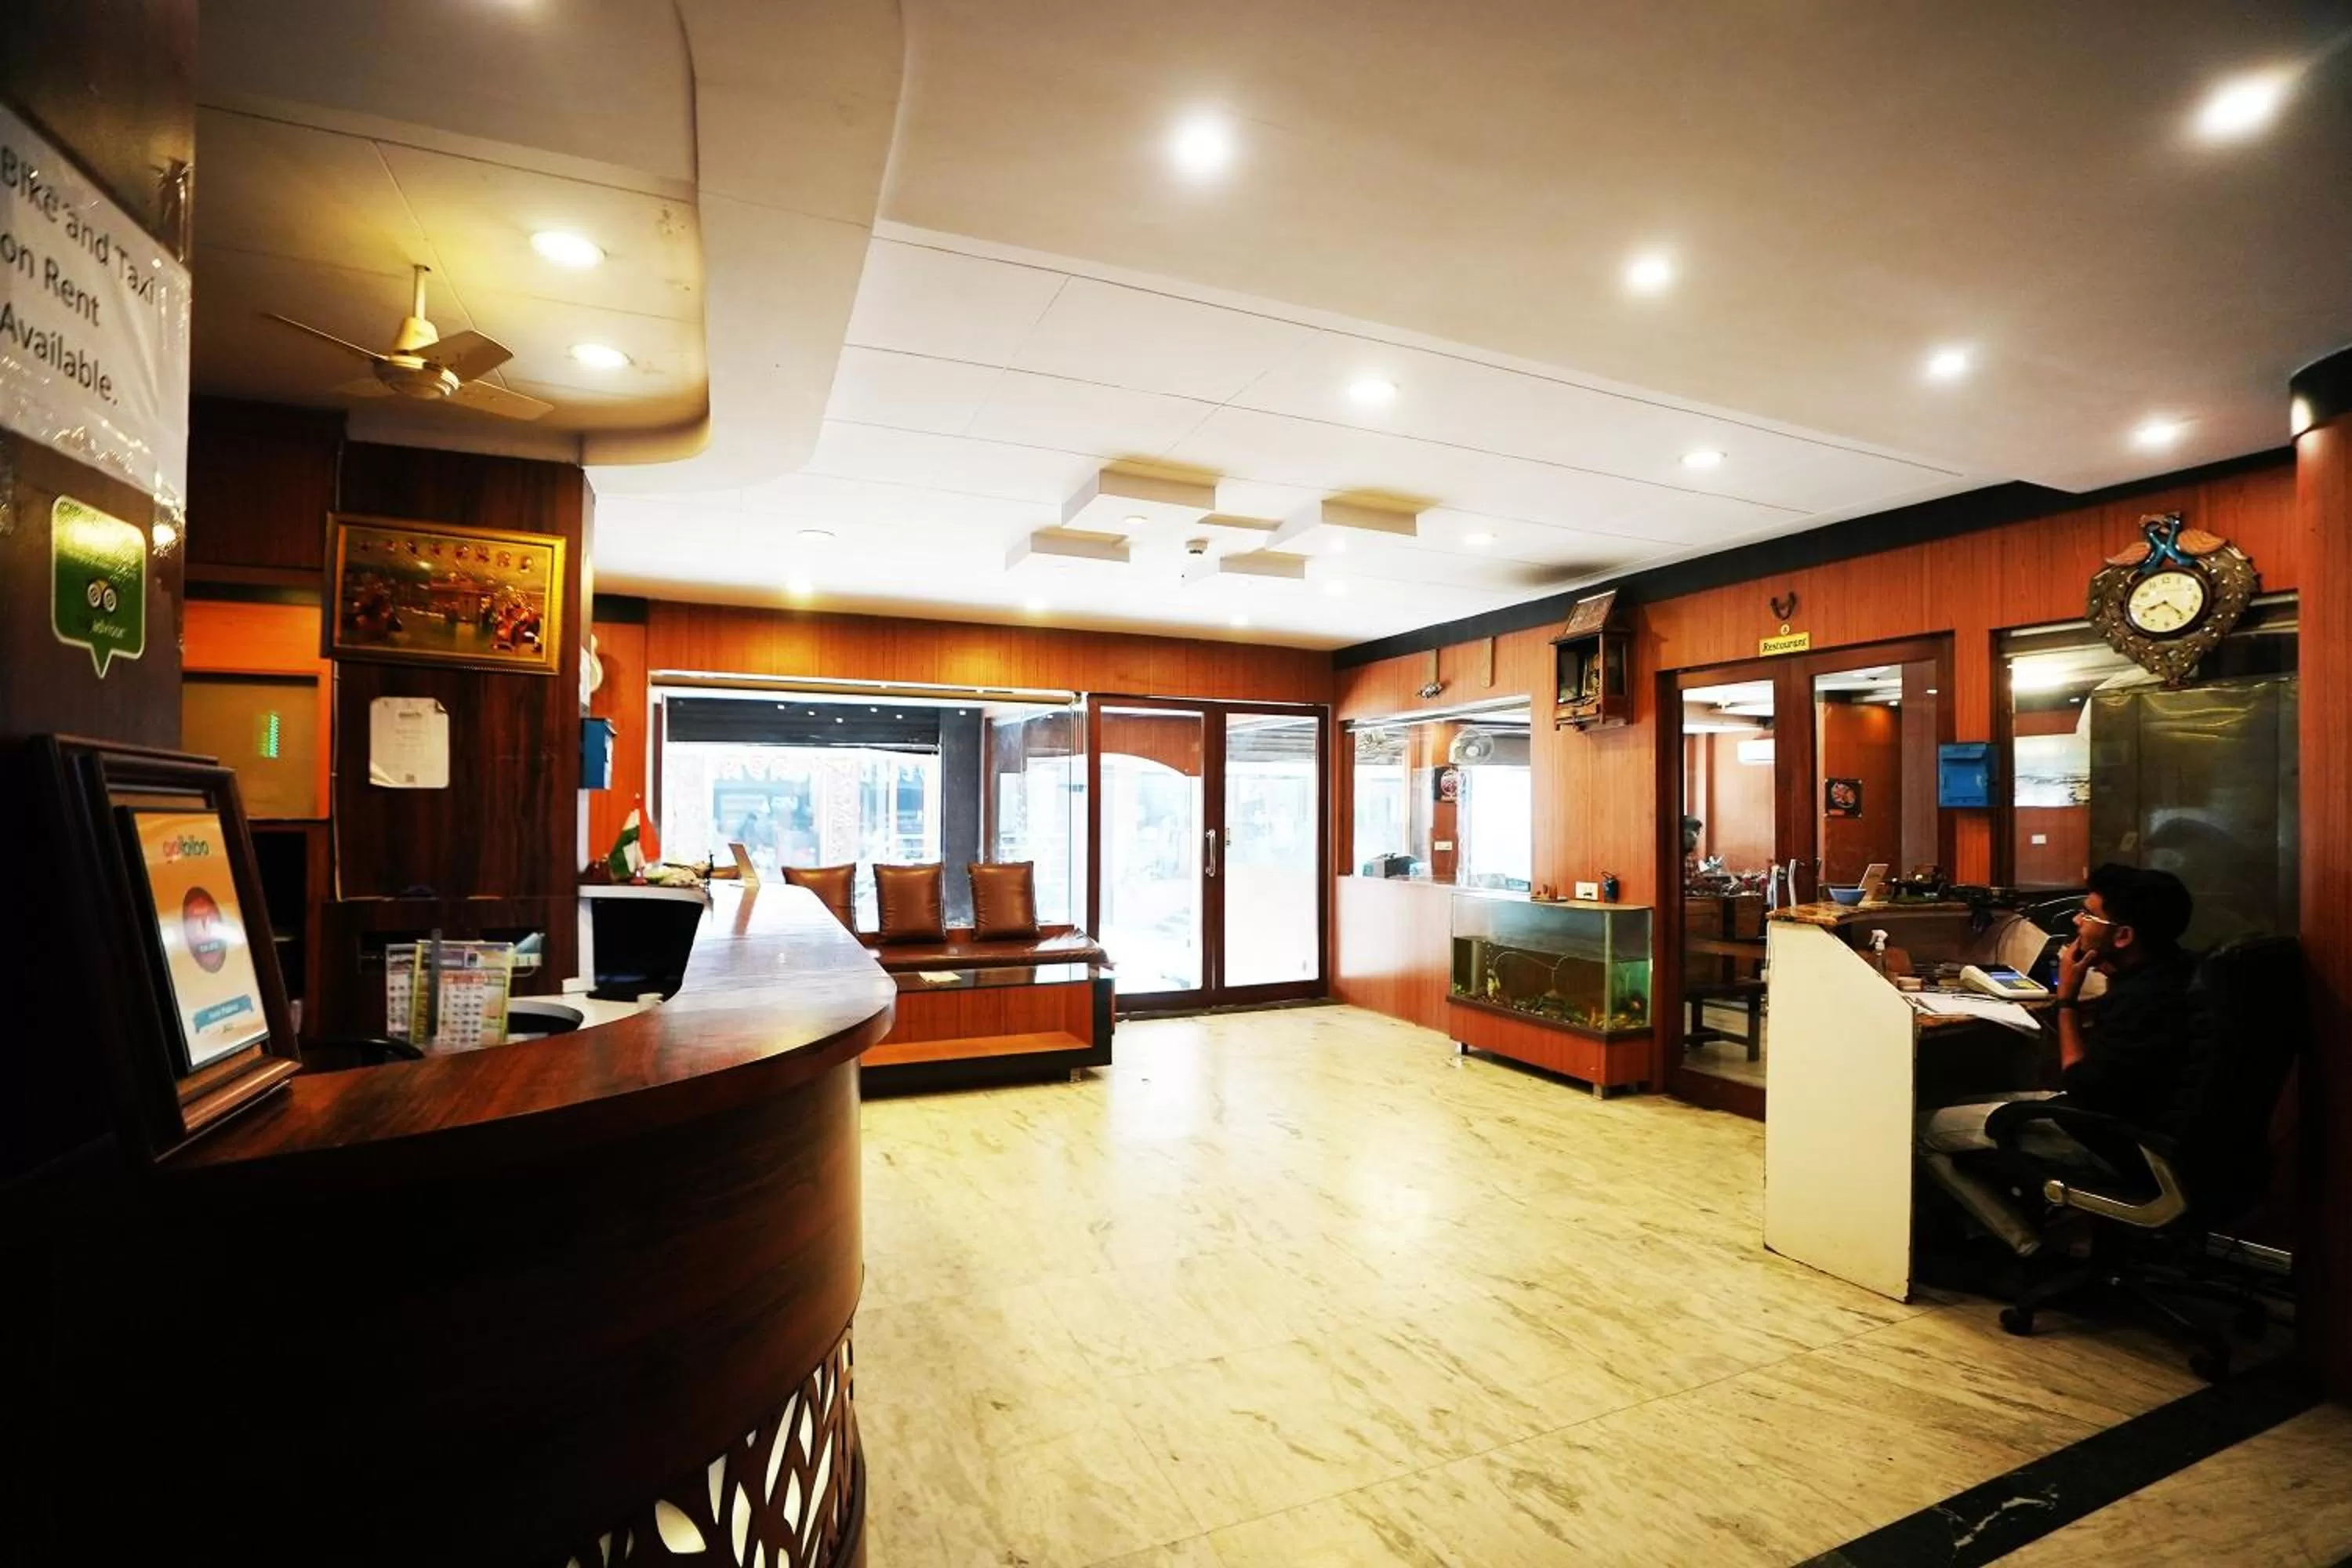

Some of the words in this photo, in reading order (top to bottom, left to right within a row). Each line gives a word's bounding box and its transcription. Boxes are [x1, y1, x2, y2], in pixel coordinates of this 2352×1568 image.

[2, 146, 59, 223] Bike
[65, 210, 110, 267] and
[114, 244, 155, 305] Taxi
[0, 232, 35, 279] on
[44, 256, 100, 327] Rent
[0, 301, 118, 407] Available.
